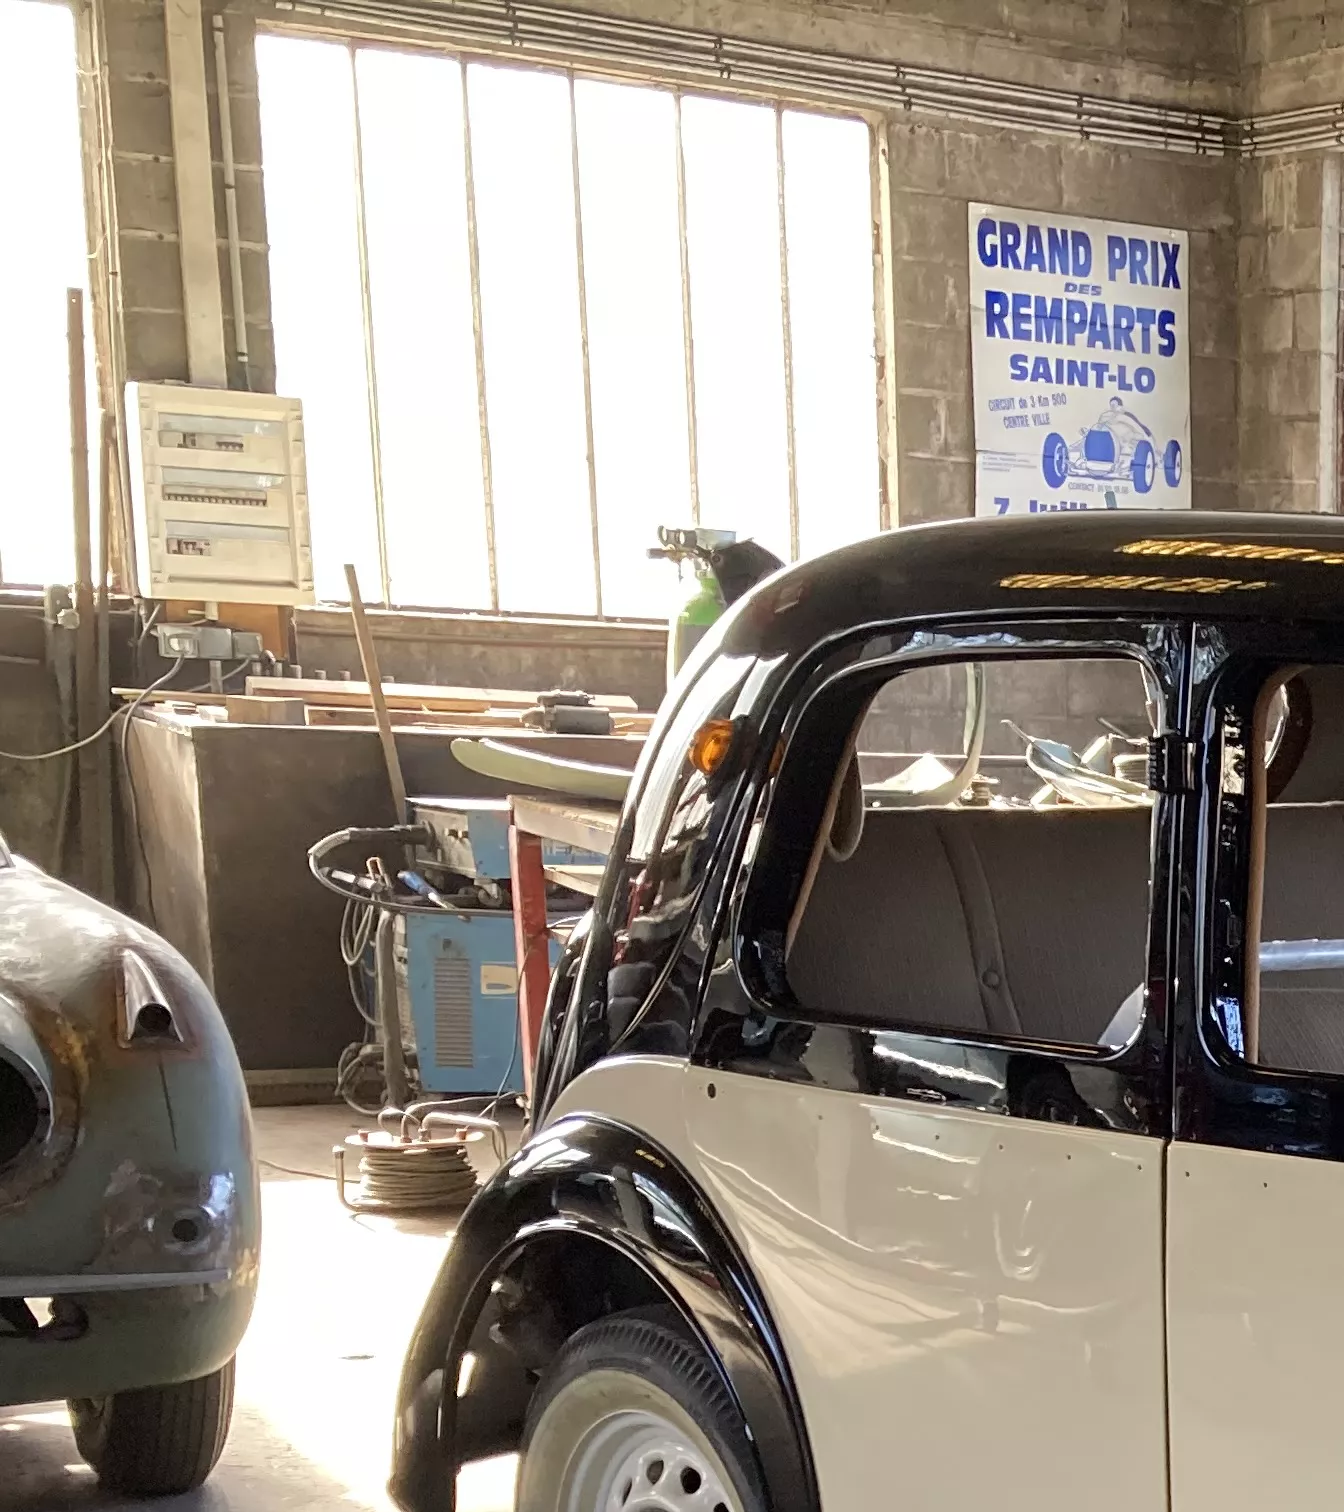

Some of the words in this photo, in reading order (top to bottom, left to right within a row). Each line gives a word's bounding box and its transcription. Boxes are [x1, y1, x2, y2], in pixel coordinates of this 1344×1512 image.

[977, 217, 1093, 278] GRAND
[1107, 235, 1182, 290] PRIX
[1064, 282, 1103, 296] DES
[985, 289, 1176, 358] REMPARTS
[1009, 353, 1156, 394] SAINT-LO
[1030, 395, 1036, 408] 3
[1052, 392, 1067, 406] 500
[1003, 414, 1029, 429] CENTRE
[1032, 412, 1050, 426] VILLE
